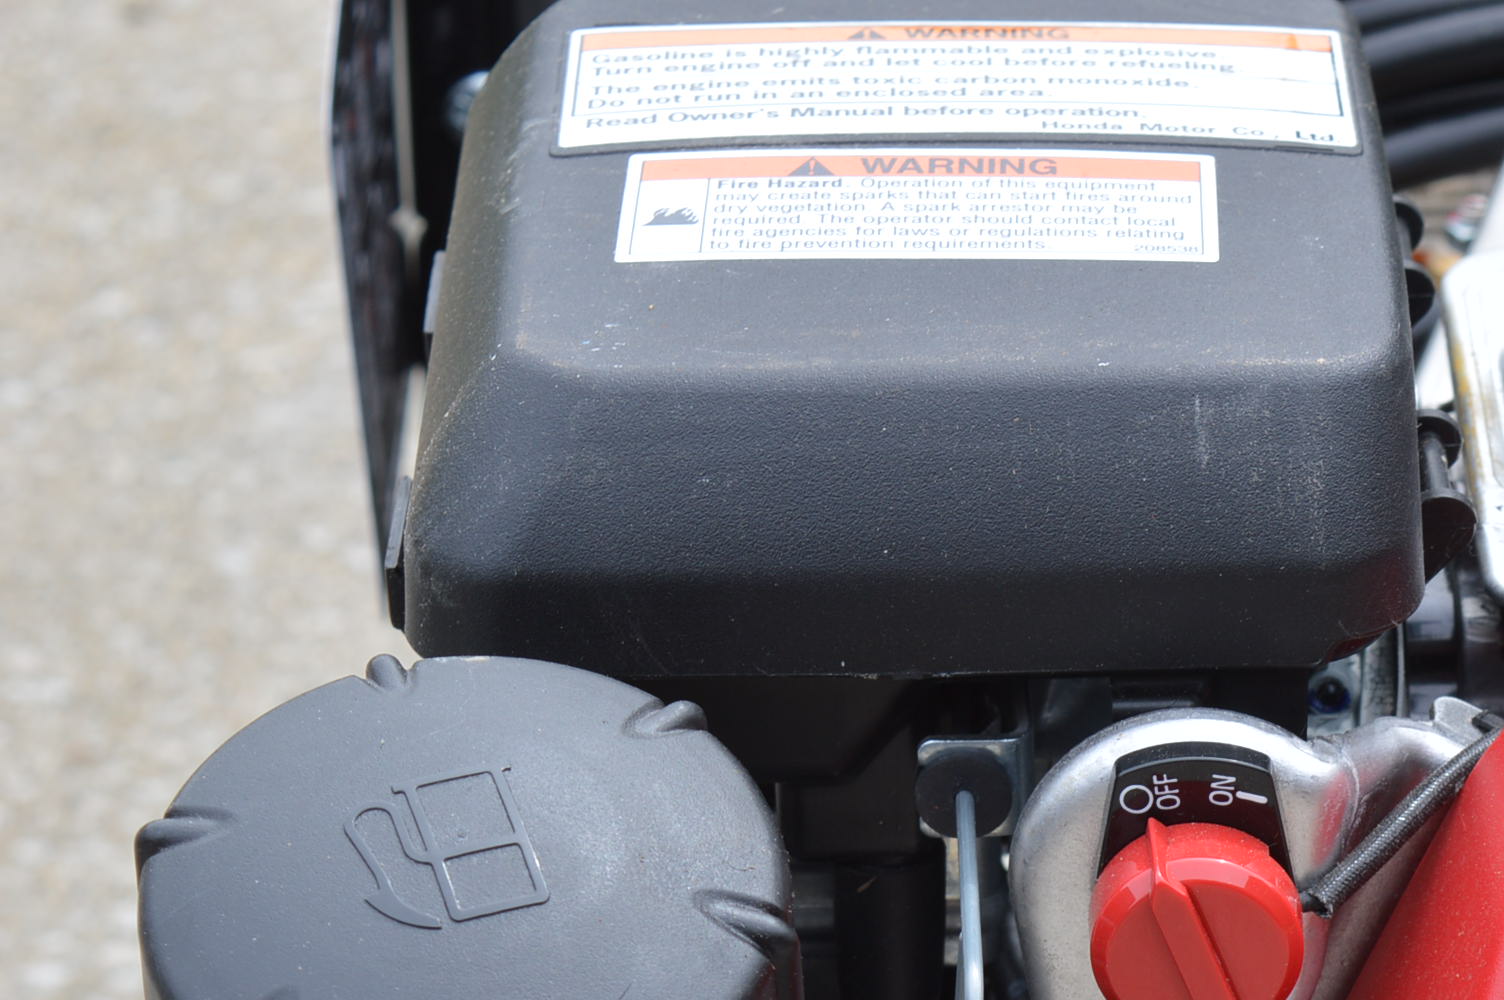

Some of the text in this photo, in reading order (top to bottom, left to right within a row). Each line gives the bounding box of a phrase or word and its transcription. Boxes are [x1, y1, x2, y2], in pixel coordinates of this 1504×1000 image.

[905, 27, 1070, 39] WARNING
[592, 50, 714, 64] Gasoline
[726, 48, 747, 58] is
[759, 46, 845, 58] highly
[857, 45, 1009, 56] flammable
[1021, 46, 1073, 55] and
[593, 65, 653, 77] Turn
[665, 60, 760, 73] engine
[773, 58, 812, 69] off
[823, 58, 875, 67] and
[887, 57, 921, 67] let
[934, 57, 993, 67] cool
[1005, 57, 1096, 68] before
[592, 84, 640, 95] The
[653, 79, 750, 92] engine
[762, 76, 840, 88] emits
[853, 75, 922, 85] toxic
[935, 75, 1037, 85] carbon
[587, 98, 624, 110] Do
[637, 95, 683, 106] not
[694, 92, 741, 102] run
[753, 90, 778, 99] in
[790, 89, 825, 98] an
[836, 87, 968, 98] enclosed
[586, 113, 658, 129] Read
[668, 107, 780, 123] Owner's
[790, 106, 893, 118] Manual
[904, 106, 995, 117] before
[1041, 120, 1123, 132] Honda
[1139, 122, 1217, 134] Motor
[1232, 125, 1279, 139] Co,
[860, 157, 1058, 175] WARNING
[717, 179, 759, 189] Fire
[860, 177, 964, 191] Operation
[971, 178, 991, 189] of
[1000, 178, 1037, 189] this
[1045, 180, 1156, 193] equipment
[715, 189, 1192, 204] may create sparks that can start fires around
[713, 202, 748, 214] dry
[881, 201, 895, 211] A
[903, 201, 960, 213] spark
[969, 202, 1052, 213] arrestor
[1061, 205, 1105, 216] may
[1113, 204, 1138, 214] be
[819, 213, 855, 224] The
[863, 214, 953, 227] operator
[961, 214, 1033, 225] should
[1040, 215, 1119, 226] contact
[1128, 216, 1176, 227] local
[711, 226, 1185, 241] fire agencies for laws or regulations relating
[709, 240, 729, 250] to
[738, 239, 772, 250] fire
[780, 239, 894, 252] prevention
[1153, 773, 1181, 810] OFF
[1208, 774, 1236, 806] ON
